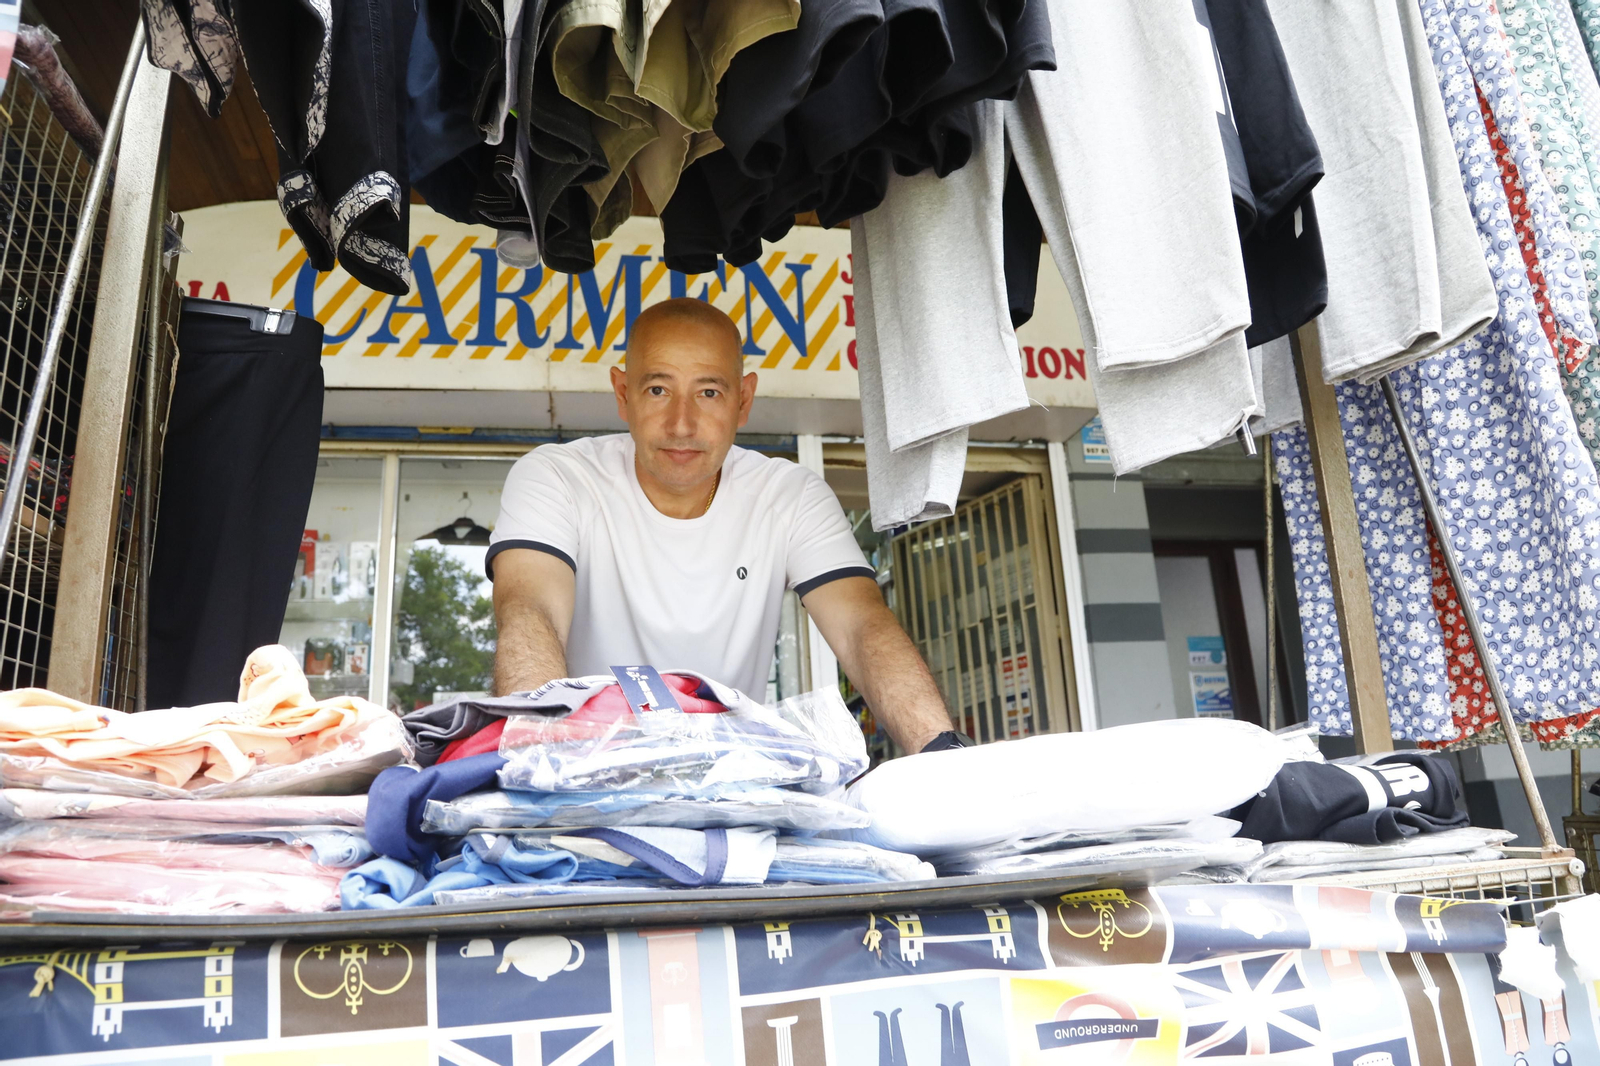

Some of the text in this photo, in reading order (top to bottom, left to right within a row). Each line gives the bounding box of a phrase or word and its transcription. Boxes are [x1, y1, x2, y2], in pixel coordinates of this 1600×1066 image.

[175, 280, 230, 301] IA
[1019, 346, 1087, 381] ION
[1054, 1024, 1139, 1040] UNDERGROUND
